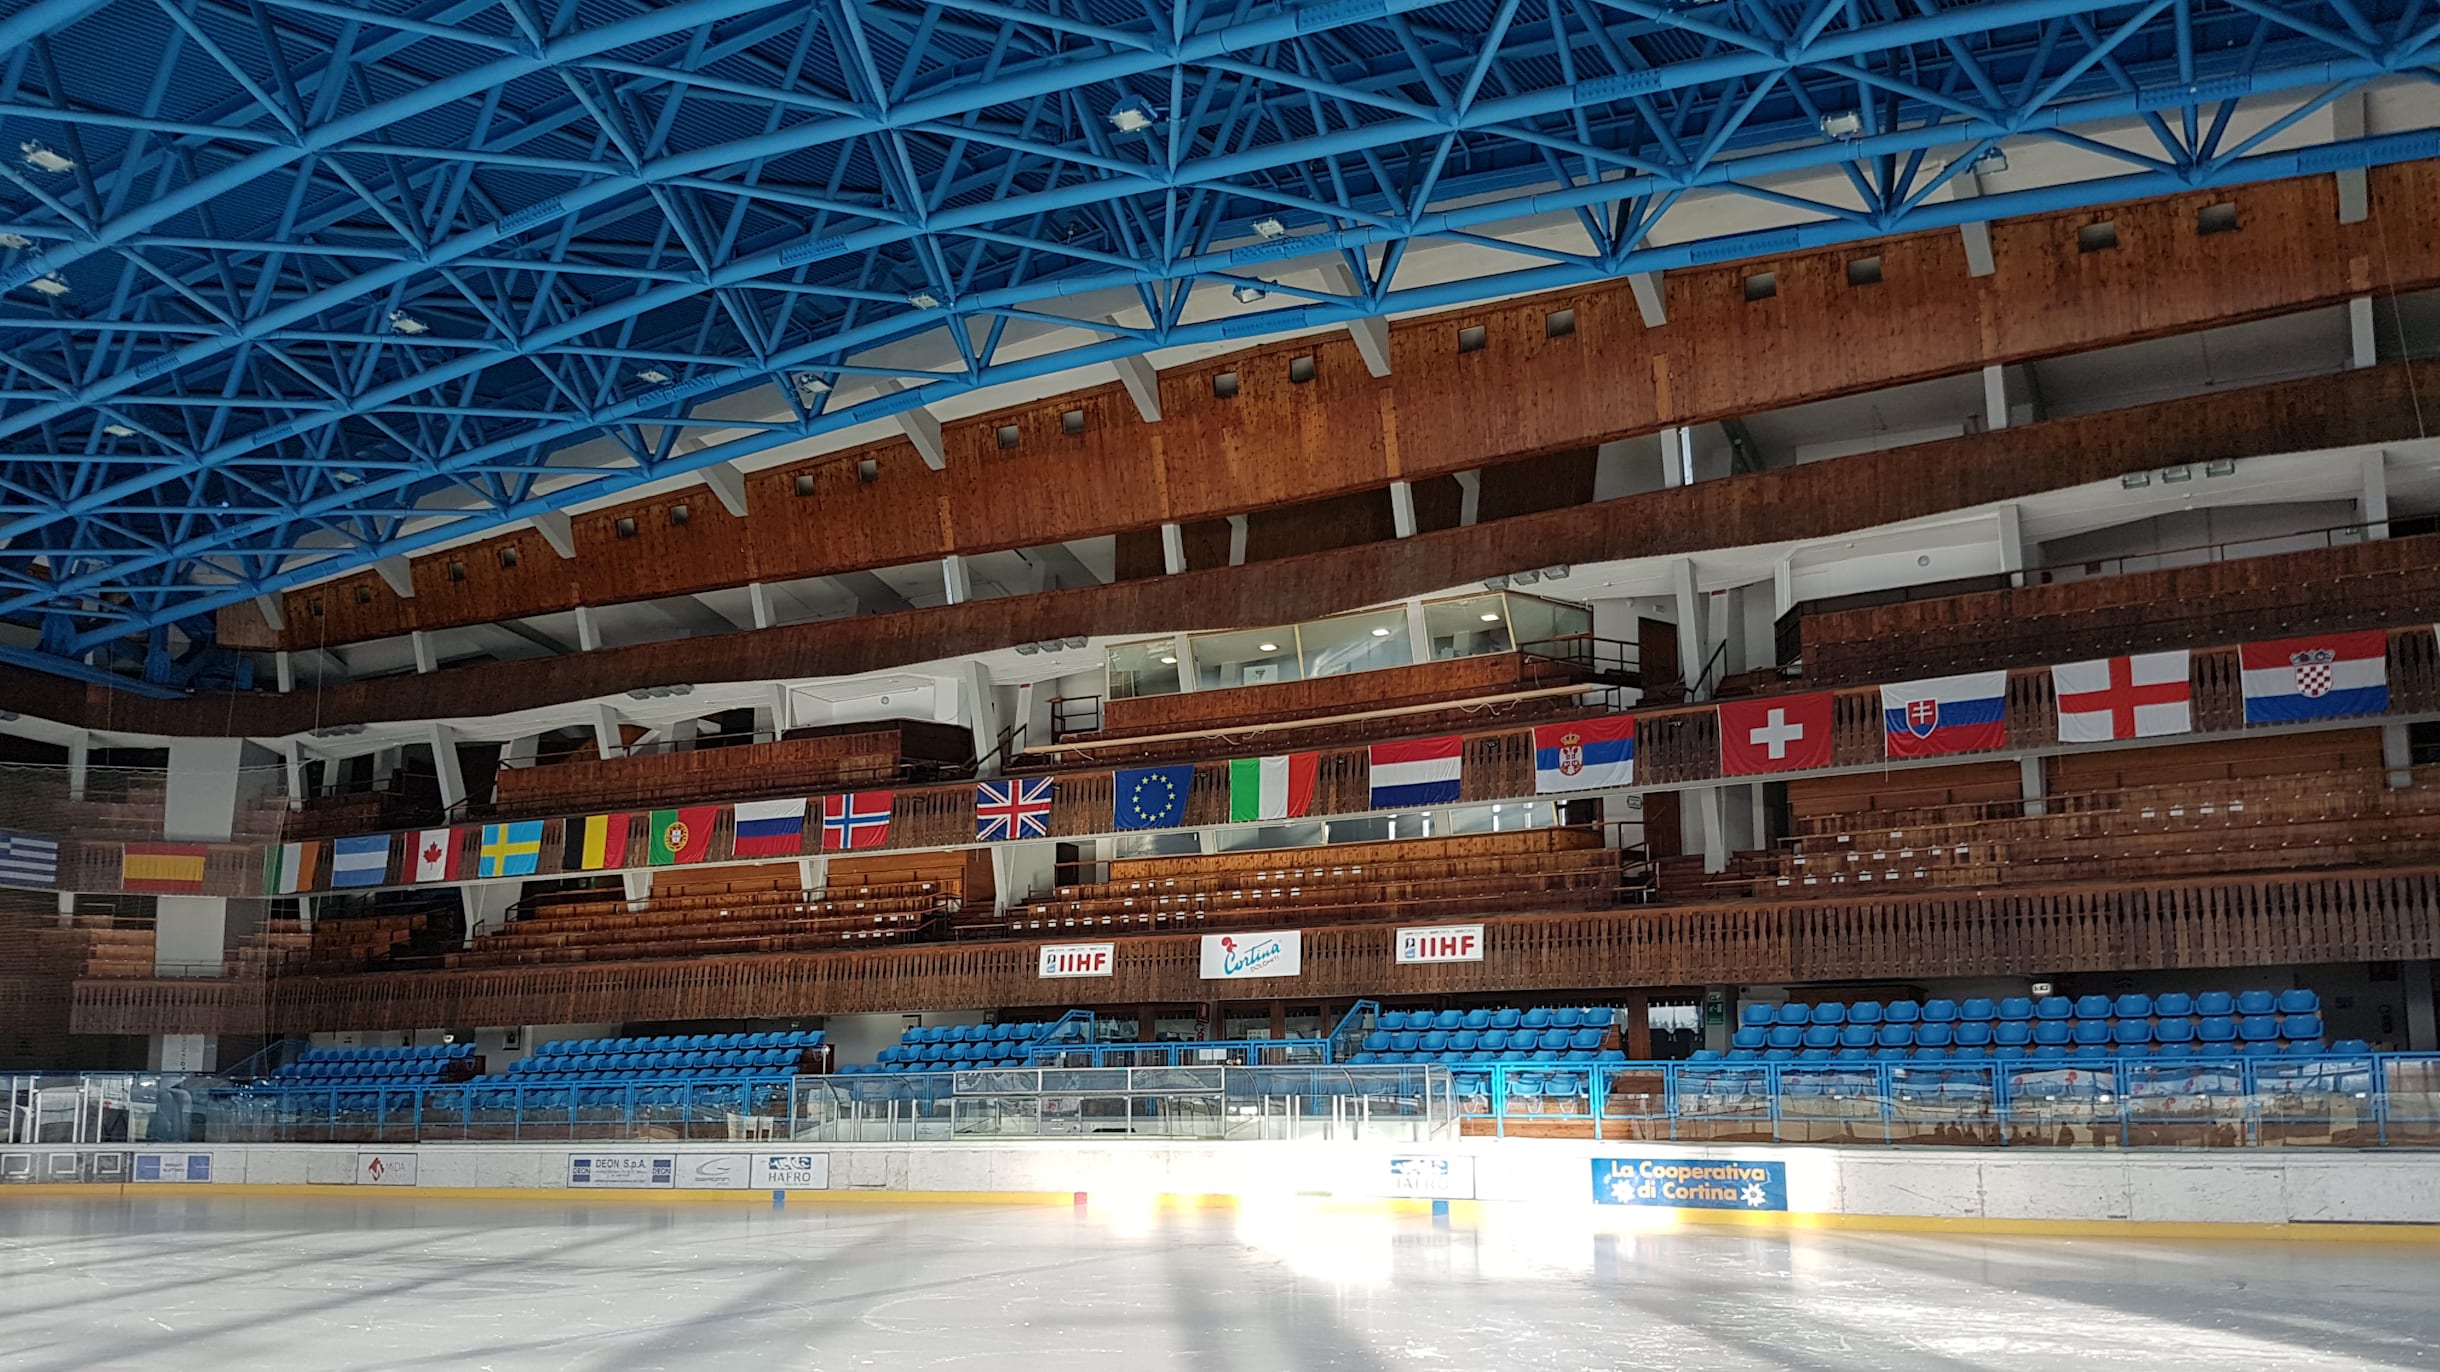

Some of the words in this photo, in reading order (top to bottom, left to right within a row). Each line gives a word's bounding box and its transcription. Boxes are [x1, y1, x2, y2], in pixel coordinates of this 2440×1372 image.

[1223, 939, 1281, 975] Cortina
[1419, 935, 1475, 958] IIHF
[1060, 952, 1106, 972] IIHF
[595, 1159, 620, 1169] DEON
[1611, 1160, 1635, 1179] La
[1638, 1160, 1767, 1184] Cooperativa
[768, 1171, 812, 1183] HAFRO
[1637, 1180, 1658, 1200] di
[1661, 1181, 1738, 1202] Cortina
